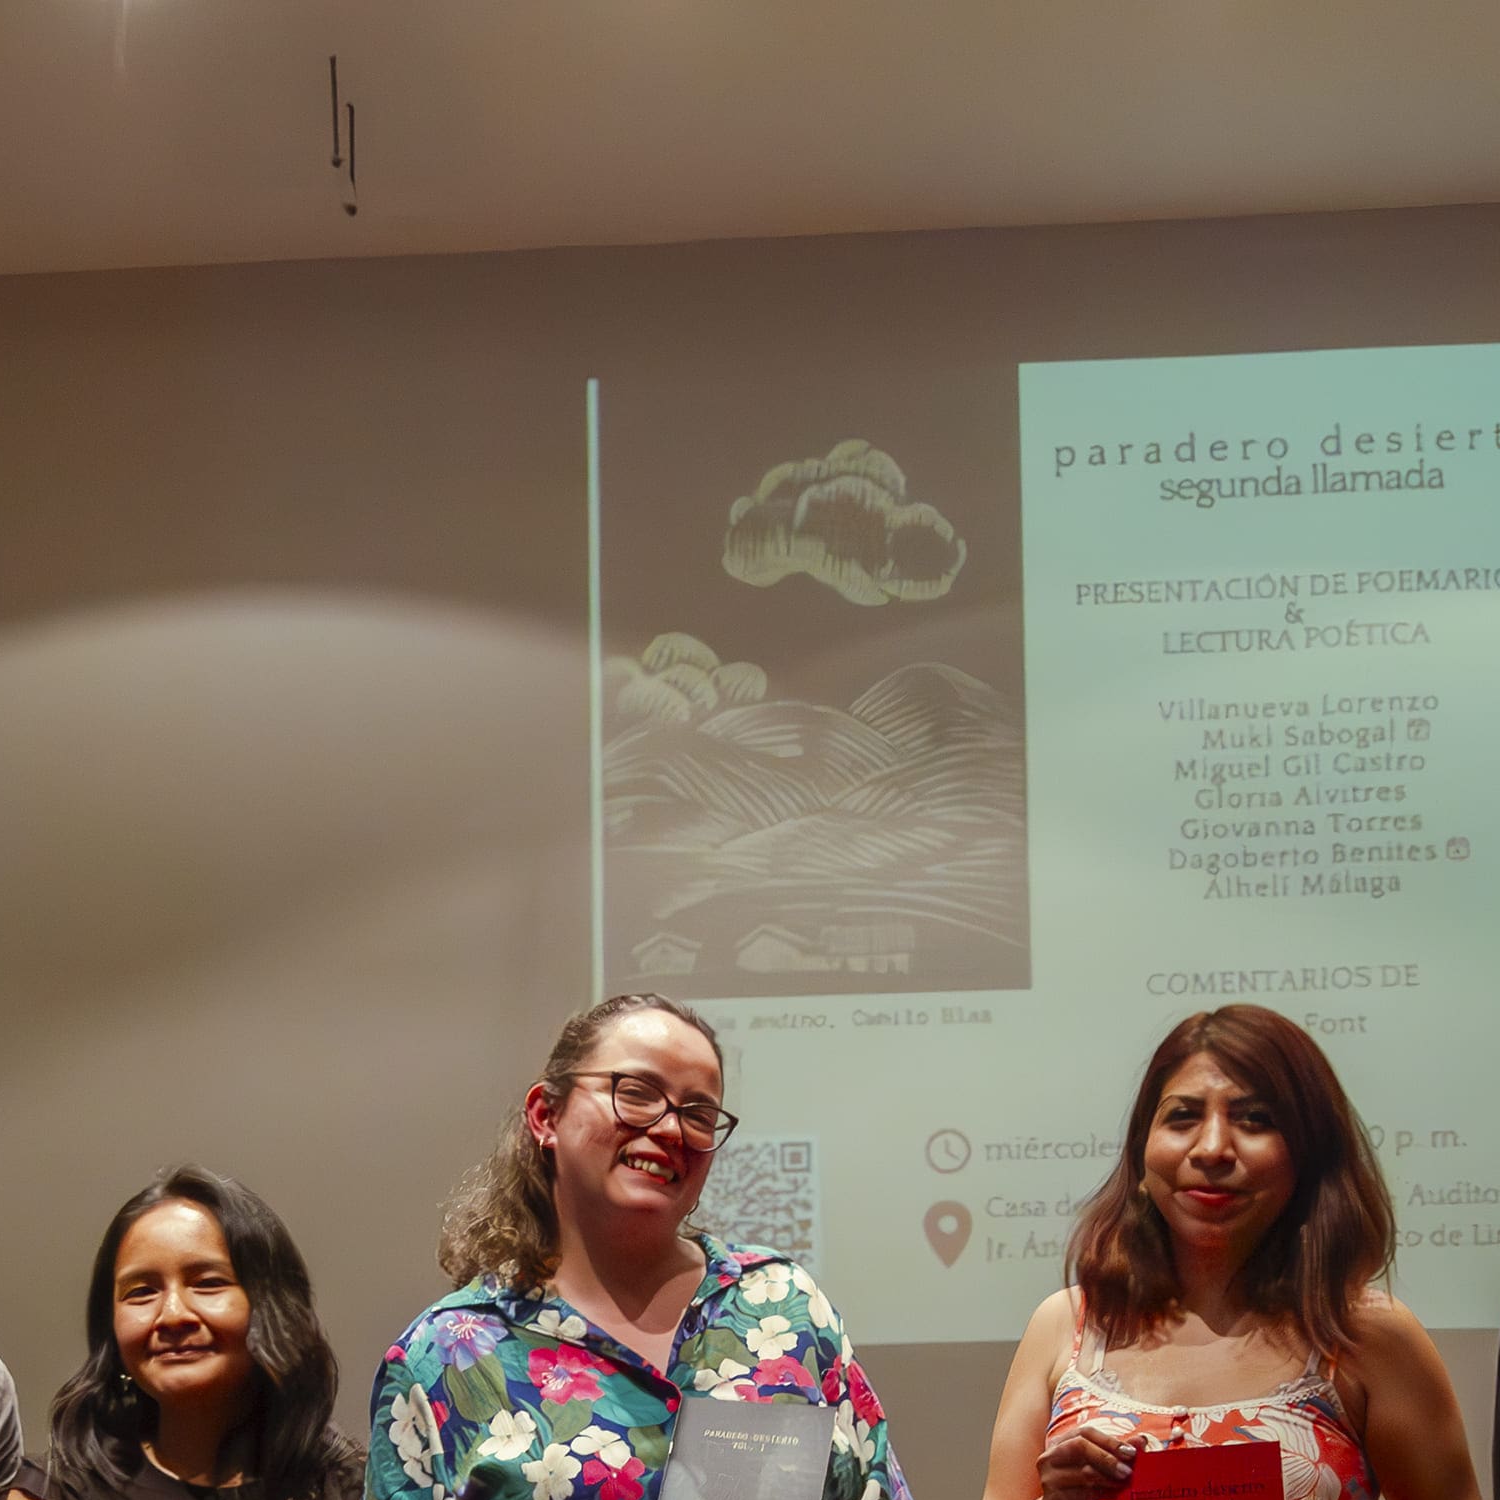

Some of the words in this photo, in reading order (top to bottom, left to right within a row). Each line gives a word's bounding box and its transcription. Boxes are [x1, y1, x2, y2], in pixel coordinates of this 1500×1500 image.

[1055, 432, 1289, 477] paradero
[1160, 466, 1301, 508] segunda
[1311, 459, 1445, 494] llamada
[1077, 573, 1299, 605] PRESENTACIÓN
[1310, 572, 1348, 596] DE
[1284, 602, 1305, 624] &
[1163, 629, 1295, 654] LECTURA
[1304, 620, 1430, 649] POÉTICA
[1159, 698, 1309, 721] Villanueva
[1322, 693, 1439, 716] Lorenzo
[1284, 719, 1395, 749] Sabogal
[1174, 755, 1269, 784] Miguel
[1283, 754, 1320, 777] Gil
[1333, 752, 1425, 774] Castro
[1195, 785, 1282, 810] Gloria
[1181, 817, 1316, 840] Giovanna
[1327, 812, 1423, 833] Torres
[1169, 845, 1319, 875] Dagoberto
[1332, 840, 1438, 864] Benites
[1204, 874, 1290, 900] Alhelí
[1302, 870, 1401, 898] Málaga
[1146, 965, 1372, 995] COMENTARIOS
[1380, 964, 1420, 988] DE
[1304, 1012, 1368, 1034] Font
[985, 1196, 1049, 1219] Casa
[1429, 1224, 1463, 1246] de
